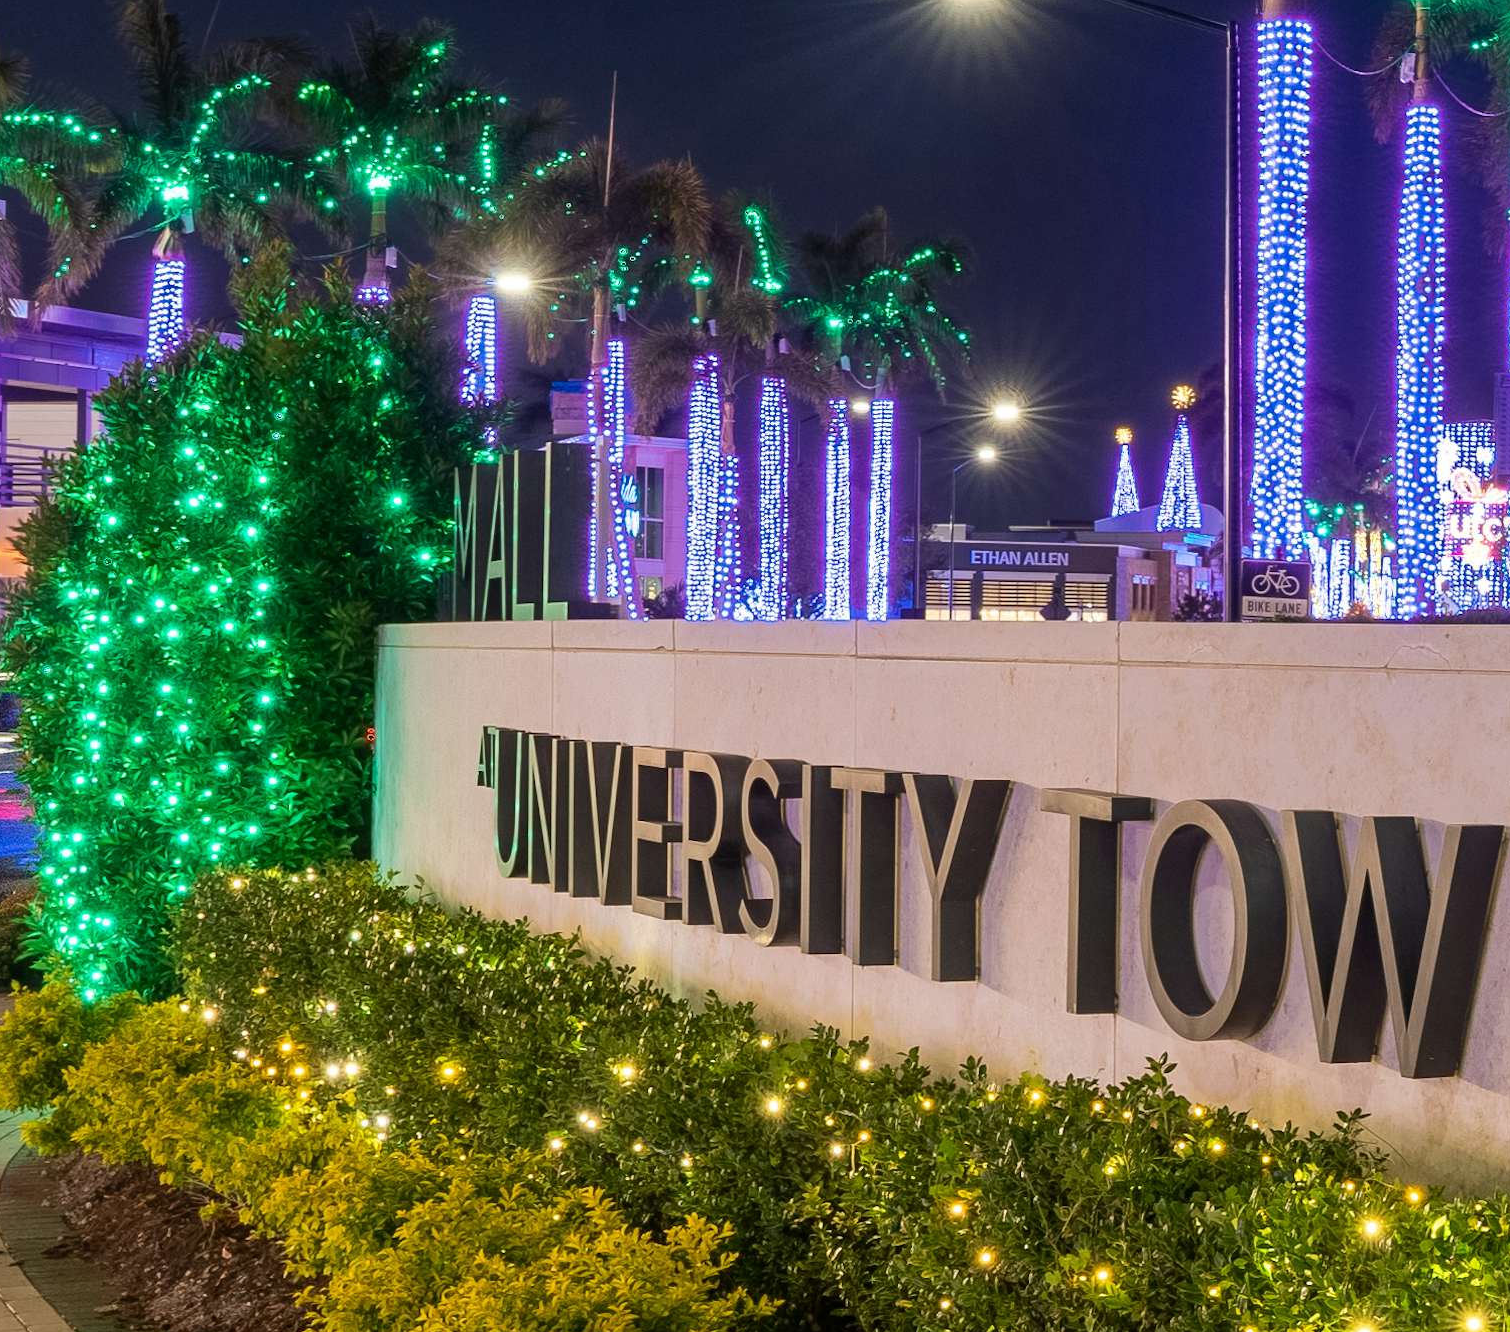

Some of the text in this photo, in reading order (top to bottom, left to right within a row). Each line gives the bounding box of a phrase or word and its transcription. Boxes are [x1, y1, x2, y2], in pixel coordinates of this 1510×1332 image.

[452, 442, 569, 621] MALL
[970, 550, 1070, 566] ETHAN ALLEN
[1247, 600, 1302, 614] BIKE LANE
[493, 726, 1012, 982] UNIVERSITY
